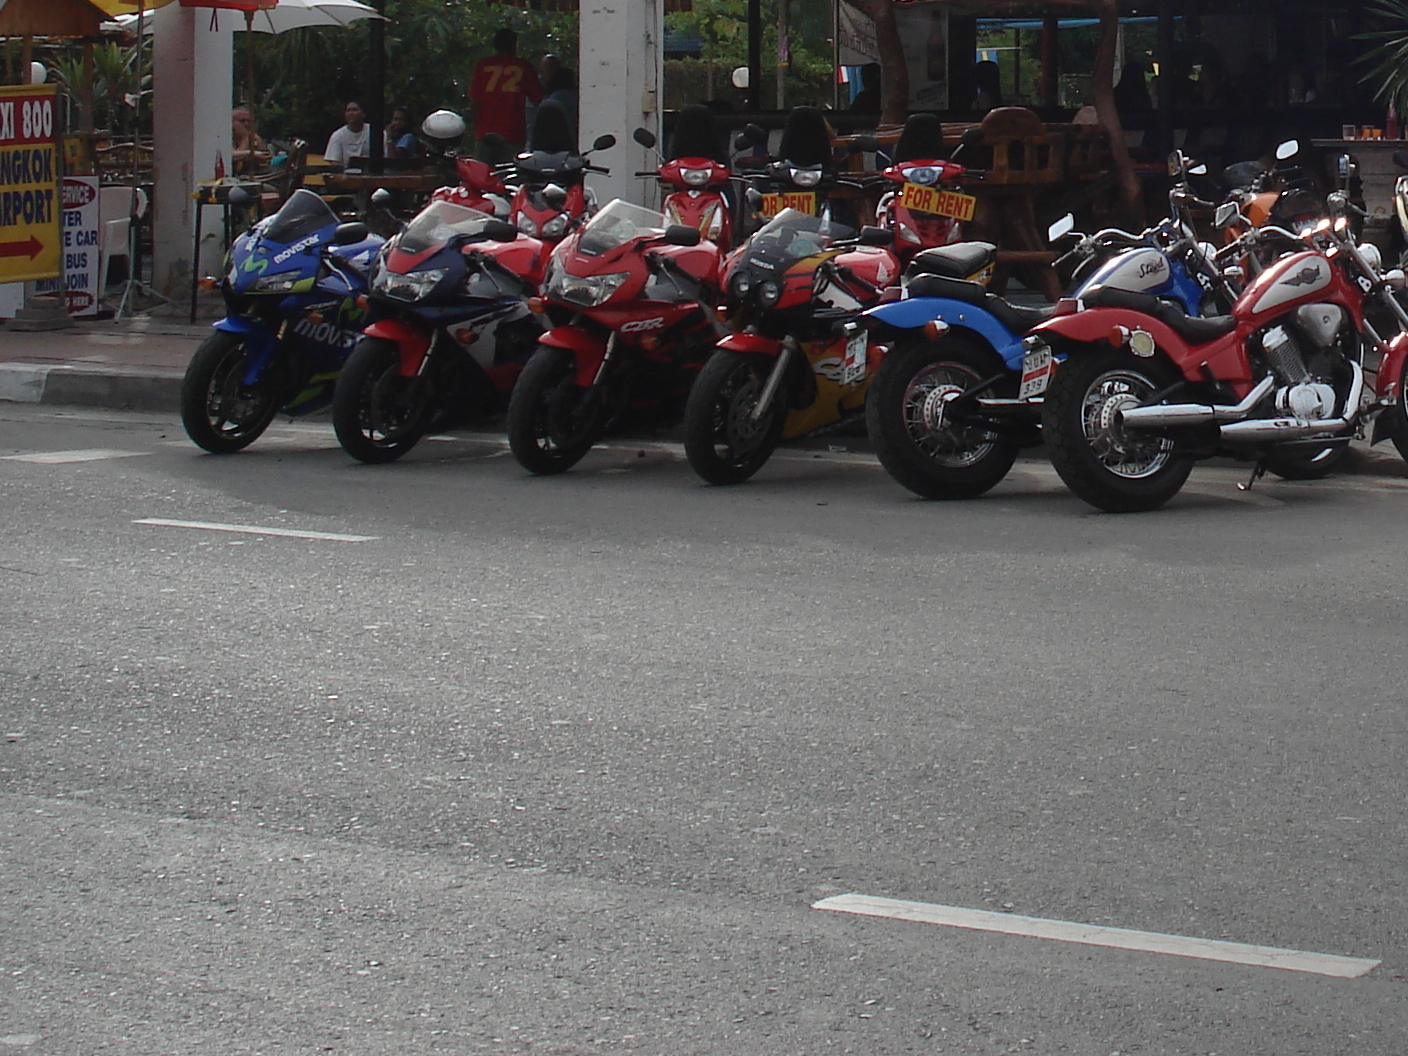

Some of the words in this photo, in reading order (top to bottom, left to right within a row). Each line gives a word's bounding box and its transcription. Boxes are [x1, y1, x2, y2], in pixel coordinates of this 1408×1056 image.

[483, 65, 523, 93] 72
[0, 102, 14, 139] XI
[22, 99, 52, 139] 800
[0, 149, 52, 185] NGKOK
[63, 186, 90, 204] ERVICE
[762, 196, 777, 216] OR
[905, 186, 932, 211] FOR
[935, 192, 973, 219] RENT
[0, 189, 52, 227] RPORT
[63, 211, 82, 227] TER
[76, 230, 98, 246] CAR
[66, 253, 88, 269] BUS
